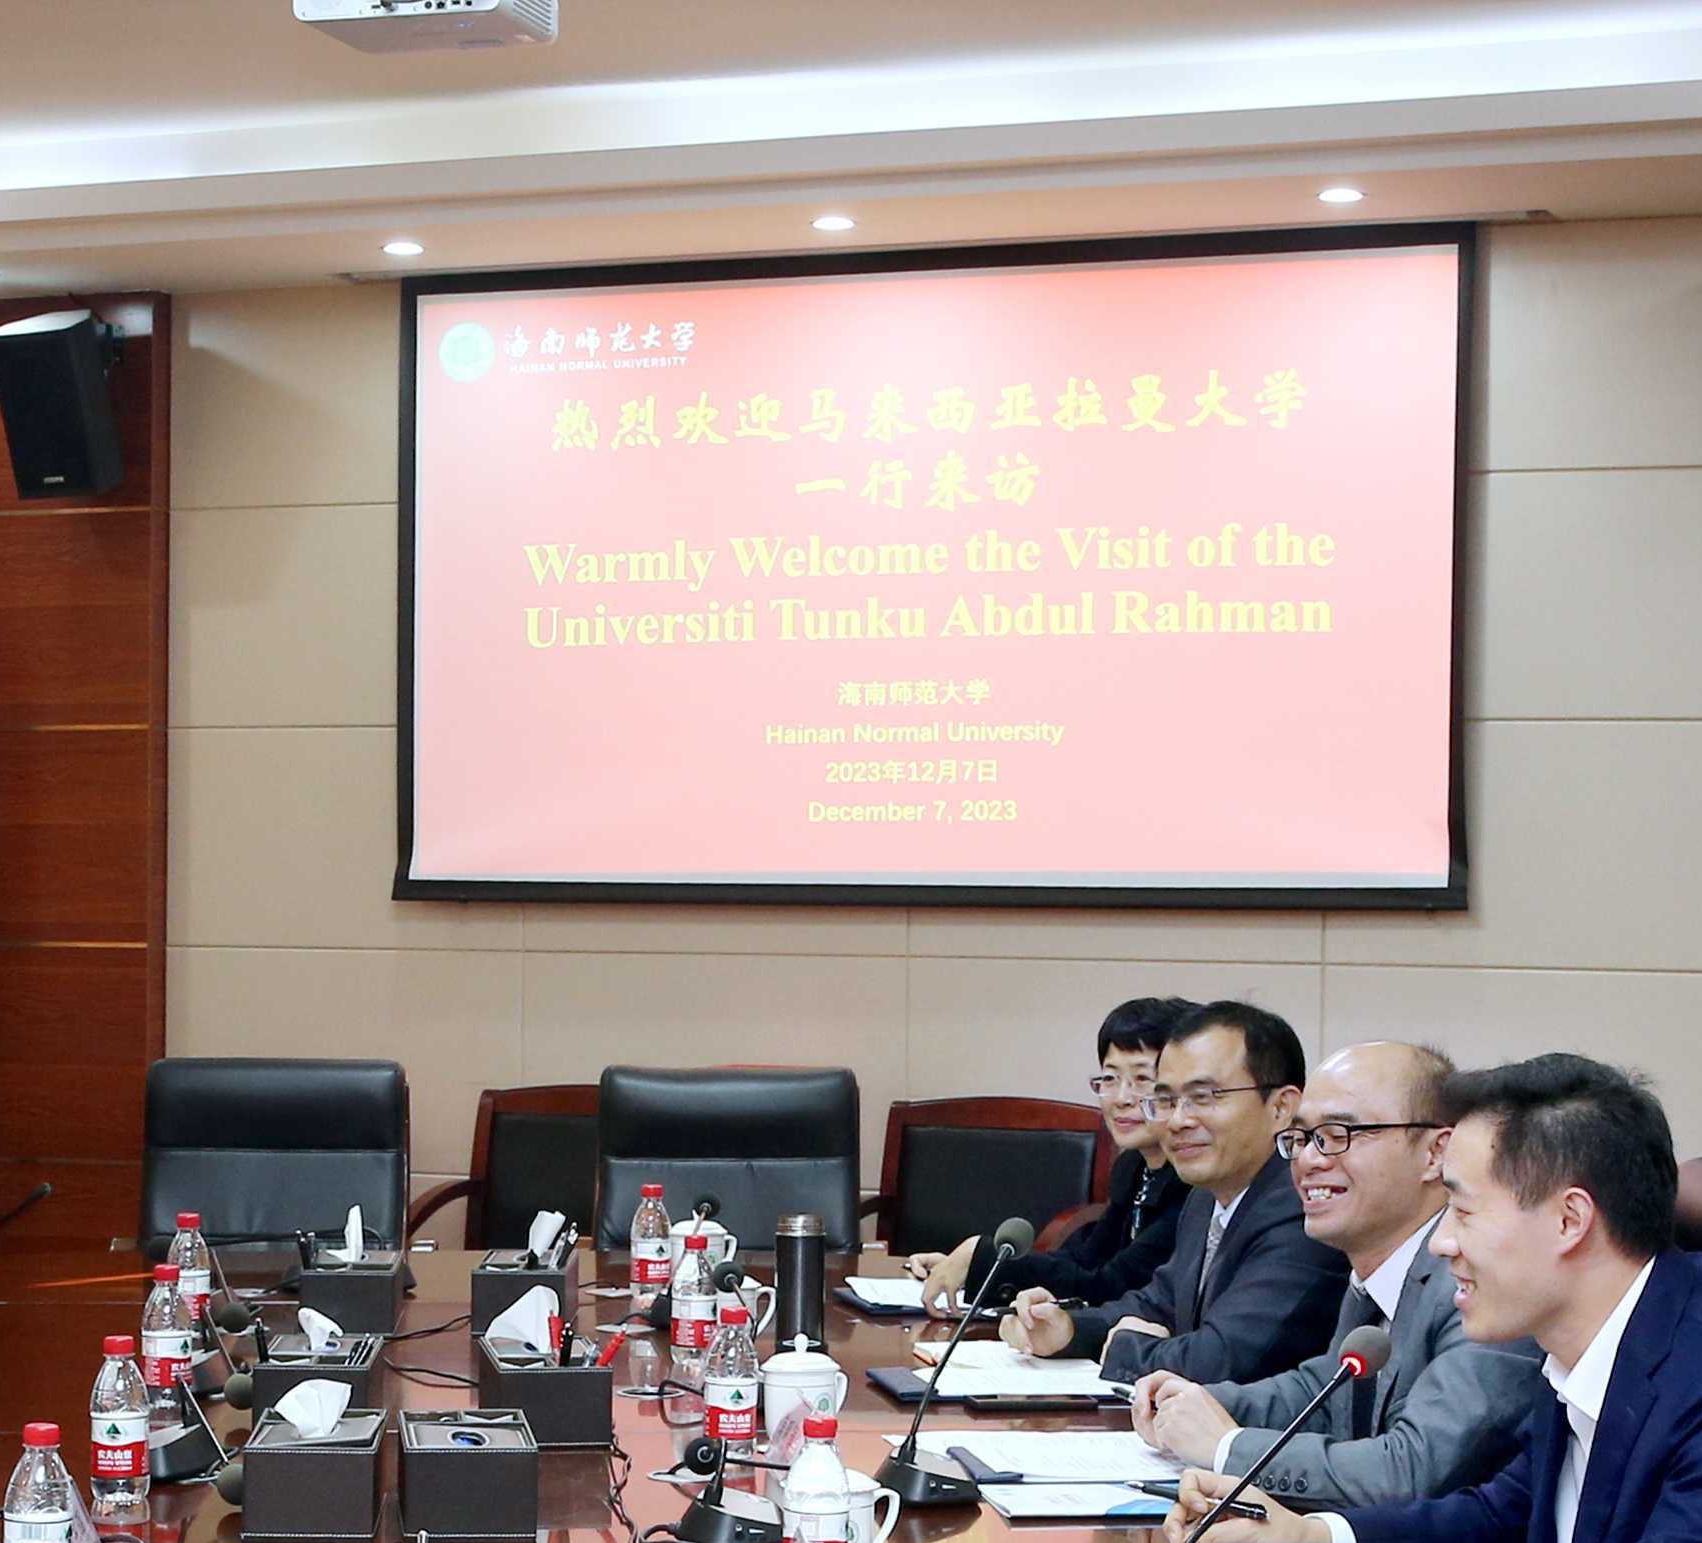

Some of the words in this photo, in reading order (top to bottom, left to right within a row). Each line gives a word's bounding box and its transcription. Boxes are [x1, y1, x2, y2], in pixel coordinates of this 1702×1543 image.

[503, 321, 696, 359] 海南师范大学
[510, 361, 555, 374] HAINAN
[559, 360, 608, 372] NORMAL
[613, 355, 688, 369] UNIVERSITY
[550, 367, 1308, 451] 热烈欢迎马来西亚拉曼大学
[795, 449, 1041, 511] 一行来访
[522, 538, 716, 592] Warmly
[729, 534, 949, 579] Welcome
[965, 529, 1042, 573] the
[1056, 525, 1173, 571] Visit
[1187, 522, 1243, 568] of
[1253, 521, 1337, 567] the
[523, 601, 757, 649] Universiti
[769, 596, 926, 642] Tunku
[939, 591, 1097, 637] Abdul
[1110, 589, 1335, 634] Rahman
[837, 678, 991, 707] 海南师范大学
[766, 724, 845, 744] Hainan
[853, 722, 940, 743] Normal
[947, 720, 1066, 746] University
[825, 759, 998, 784] 2023年12月7日
[808, 800, 926, 822] December
[933, 800, 954, 825] 7,
[960, 799, 1018, 821] 2023
